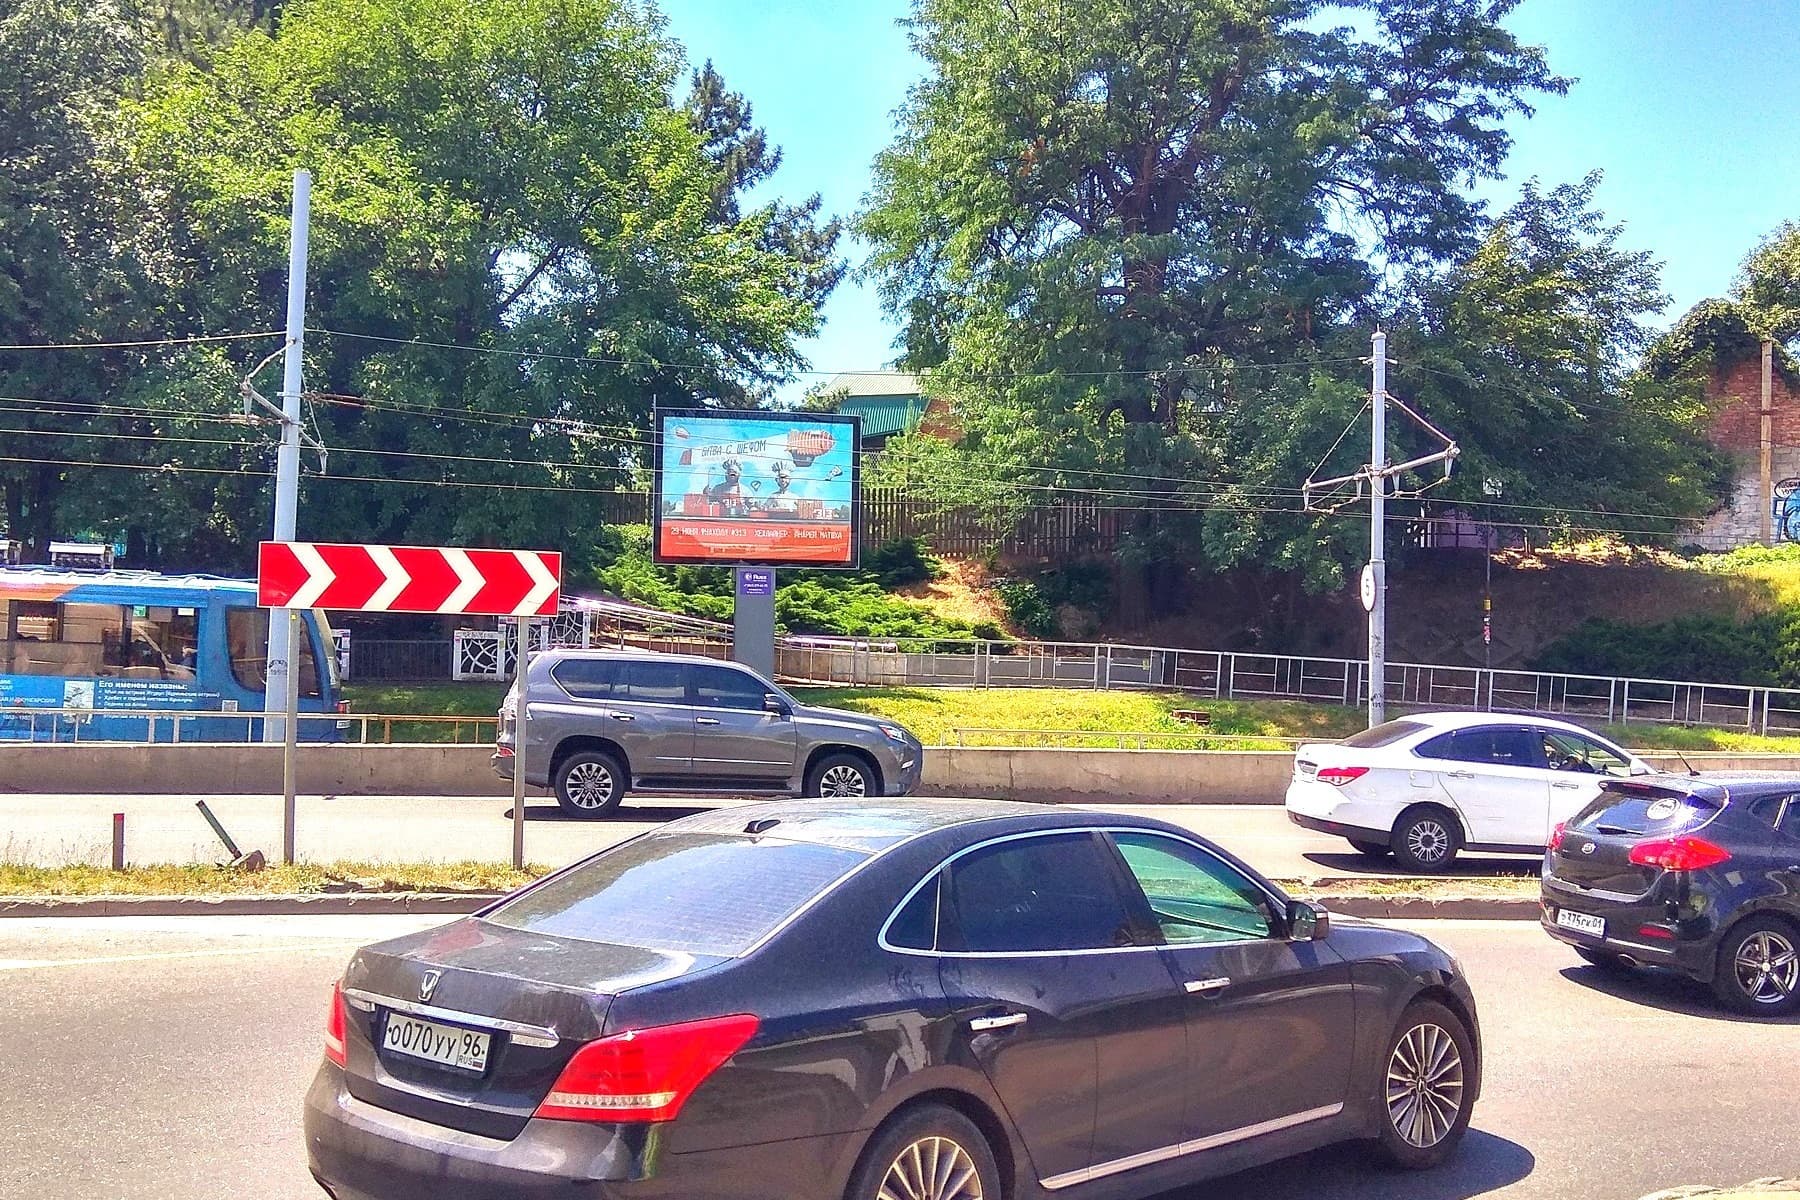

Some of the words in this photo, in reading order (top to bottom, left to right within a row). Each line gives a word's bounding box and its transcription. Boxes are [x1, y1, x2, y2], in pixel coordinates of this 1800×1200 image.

[725, 444, 733, 455] С
[737, 439, 767, 455] ШЕФОМ
[814, 508, 833, 520] 313
[463, 1033, 481, 1058] 96
[458, 1054, 473, 1067] RUS
